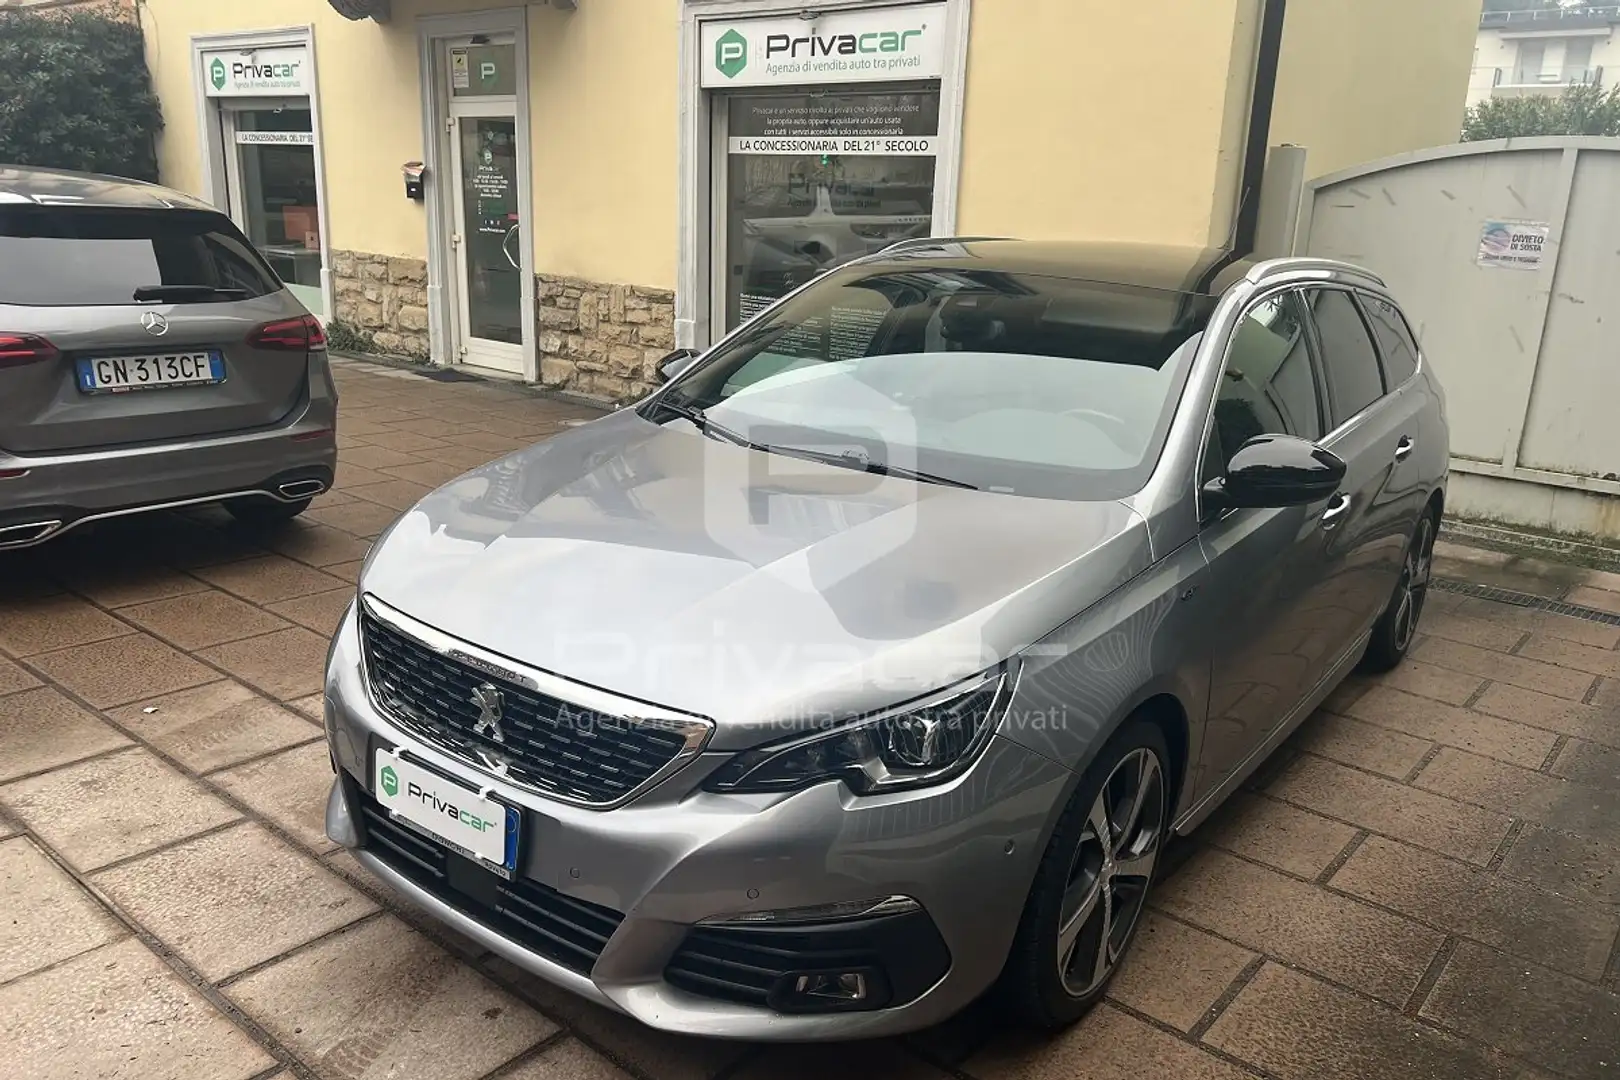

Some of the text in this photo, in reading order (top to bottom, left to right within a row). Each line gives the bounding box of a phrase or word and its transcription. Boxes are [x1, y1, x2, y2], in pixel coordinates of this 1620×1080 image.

[766, 27, 922, 59] Privacar
[232, 60, 300, 78] Privacar
[766, 55, 921, 76] Agenzia di vendita auto tra privati
[740, 140, 929, 152] LA CONCESSIONARIA DEL 21° SECOLO
[1510, 243, 1542, 252] DI SOSTA
[1511, 234, 1544, 244] DIVIETO
[97, 354, 205, 384] GN 313CF
[407, 781, 494, 833] Privacar
